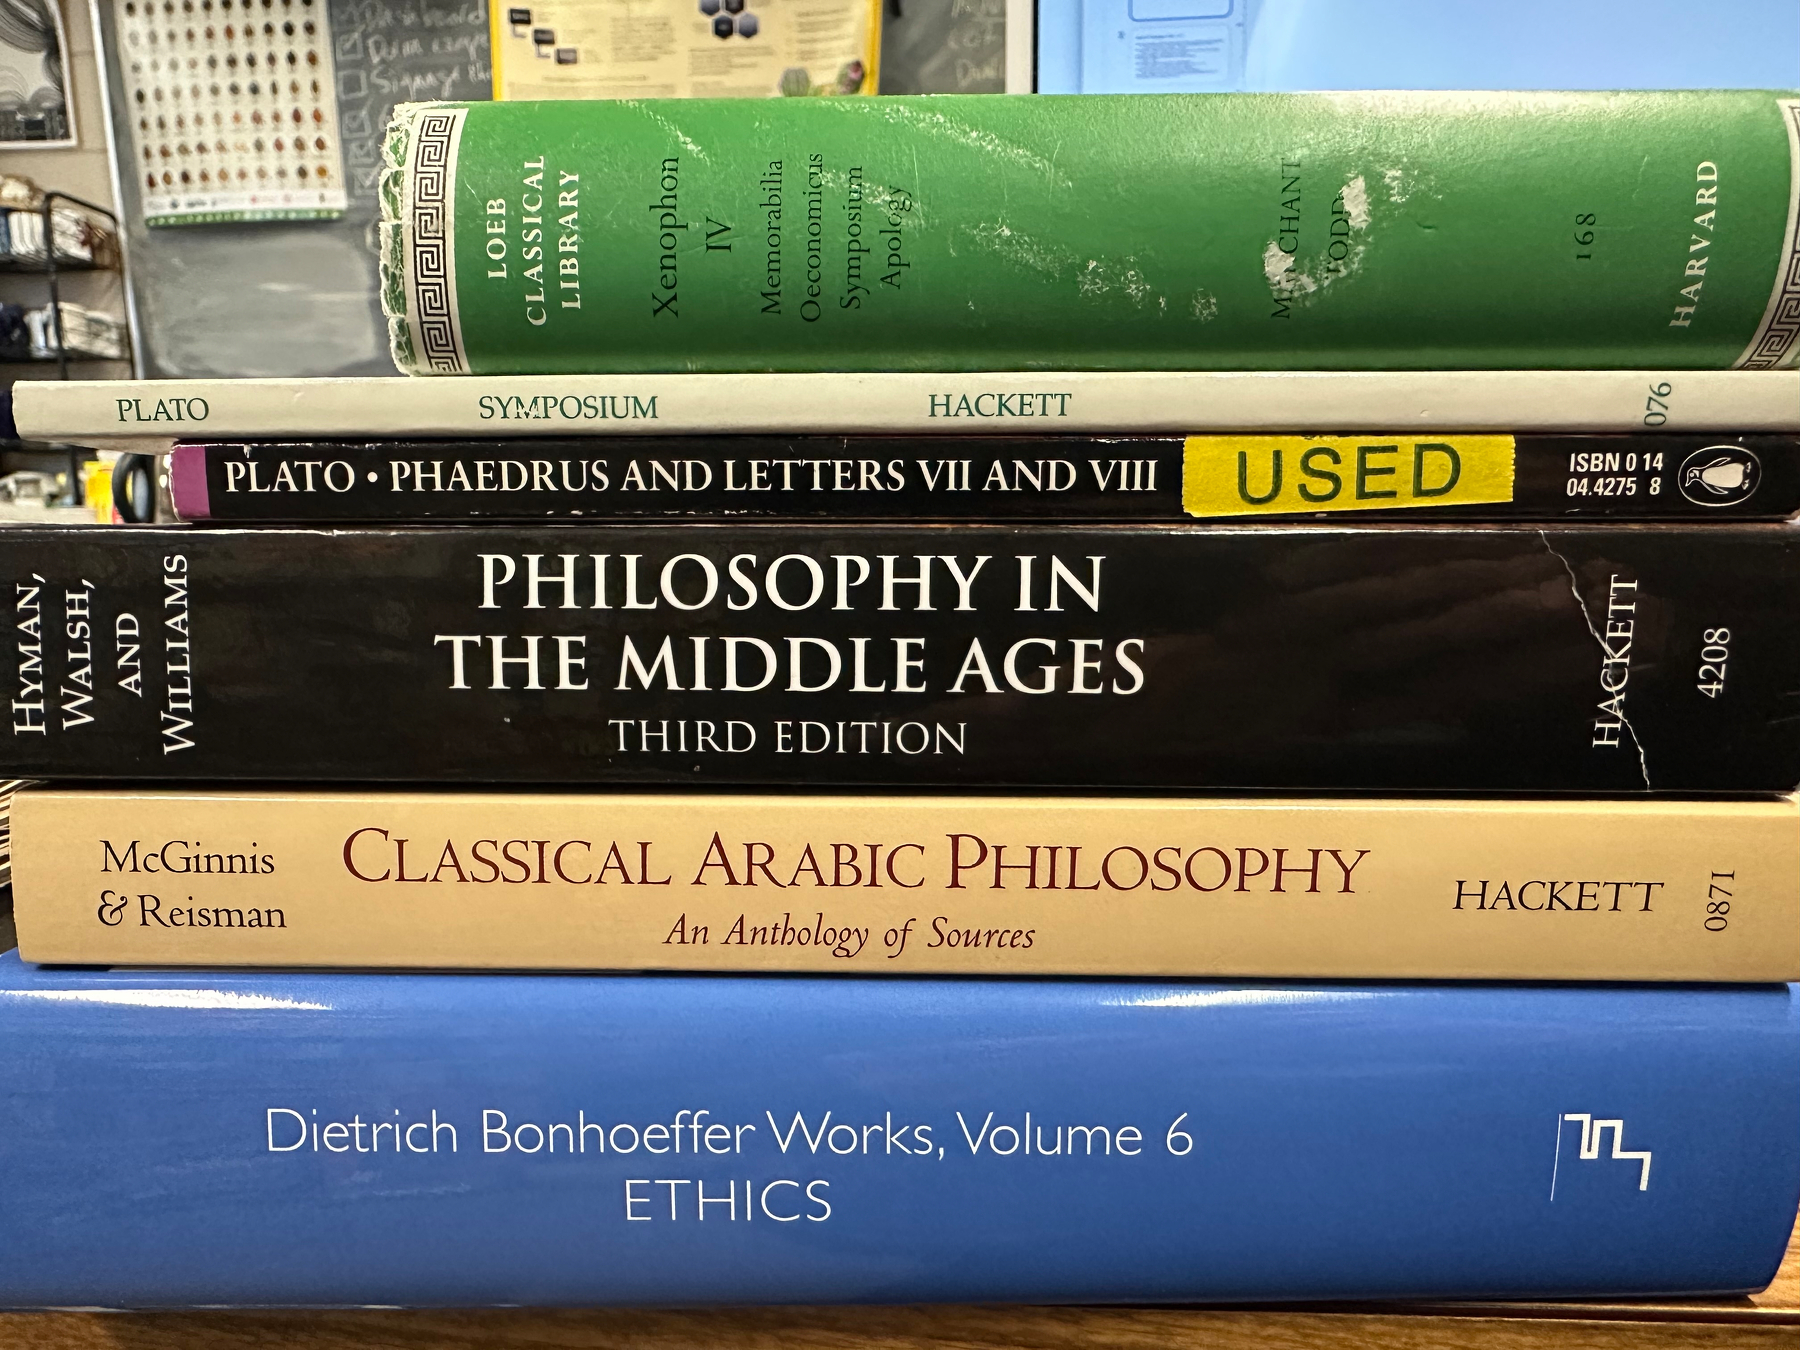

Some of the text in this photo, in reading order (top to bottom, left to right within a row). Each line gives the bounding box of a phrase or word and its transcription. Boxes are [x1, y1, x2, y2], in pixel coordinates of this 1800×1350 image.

[487, 199, 507, 278] LOEB
[522, 156, 546, 325] CLASSICAL
[559, 171, 580, 309] LIBRARY
[649, 157, 688, 316] Xenophon
[706, 216, 731, 253] IV
[759, 160, 782, 312] Memorabilia
[800, 153, 823, 322] Oeconomicus
[839, 166, 871, 309] Symposium
[1270, 157, 1300, 319] MCHANT
[1574, 213, 1596, 259] 168
[1670, 161, 1717, 326] HARVARD
[116, 398, 209, 422] PLATO
[479, 396, 658, 419] SYMPOSIUM
[929, 394, 1072, 417] HACKETT
[1643, 381, 1672, 426] 076
[224, 459, 1158, 492] PLATO PHAEDRUS AND LETTERS VII AND VIII
[1238, 443, 1461, 505] USED
[1570, 453, 1663, 472] ISBN 0 14
[1650, 477, 1661, 495] 8
[477, 554, 1106, 612] PHILOSOPHY IN
[12, 573, 46, 735] HYMAN,
[61, 579, 94, 730] WALSH,
[116, 613, 141, 697] AND
[161, 555, 195, 755] WILLIAMS
[434, 635, 1144, 694] THE MIDDLE AGES
[1593, 574, 1638, 748] HACKETT
[1697, 628, 1730, 698] 4208
[609, 720, 966, 754] THIRD EDITION
[100, 840, 274, 874] McGinnis
[343, 828, 1370, 893] CLASSICAL ARABIC PHILOSOPHY
[98, 890, 287, 927] & Reisman
[1453, 880, 1664, 911] HACKETT
[1704, 871, 1734, 931] 0871
[662, 913, 1035, 958] An Anthology of Sources
[267, 1109, 1192, 1160] Dietrich Bonhoeffer Works, Volume 6
[626, 1180, 831, 1221] ETHICS
